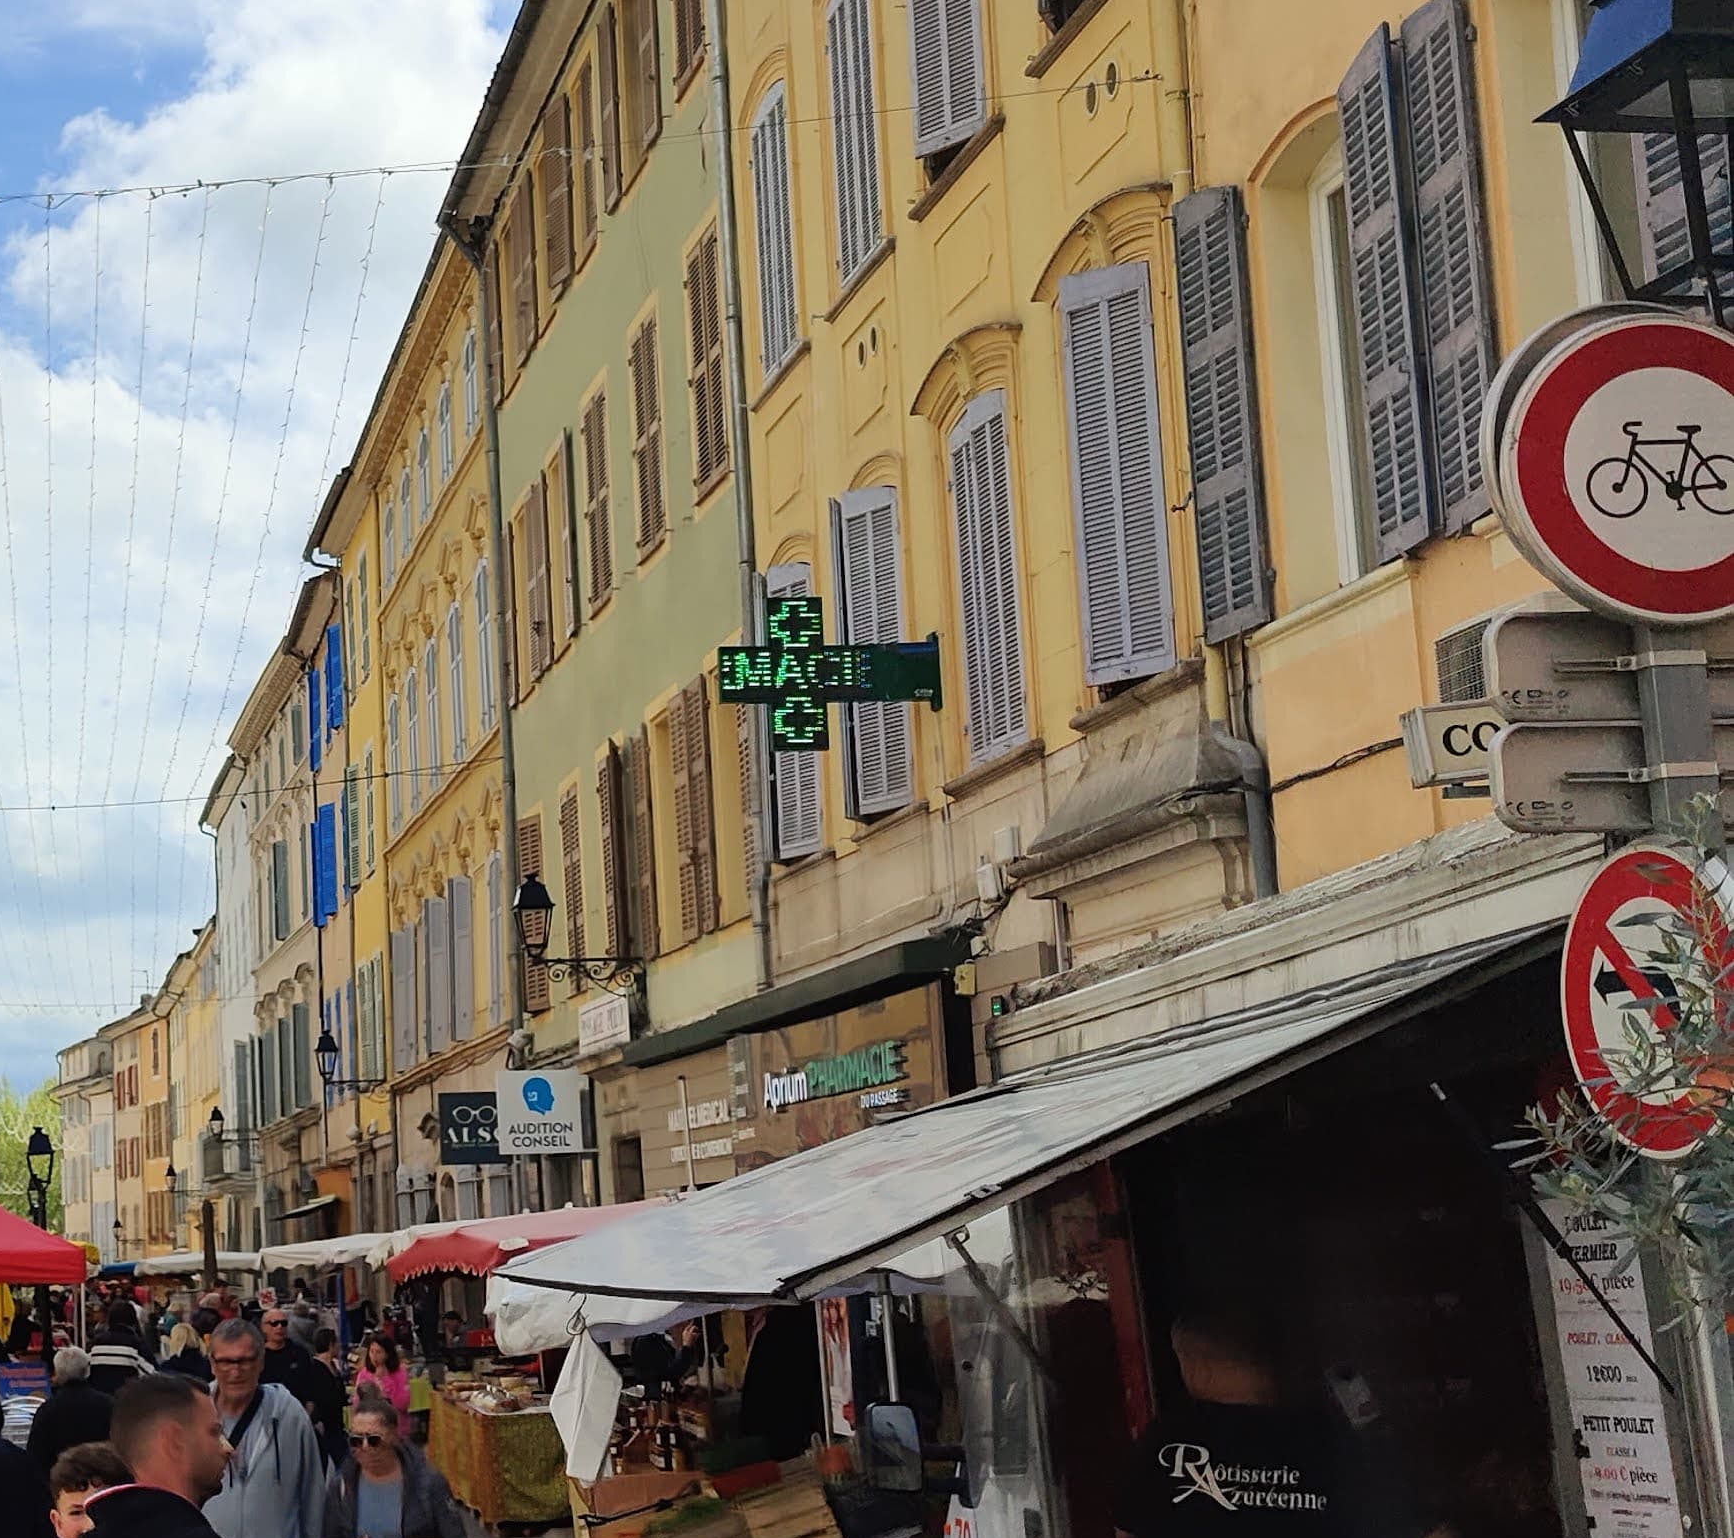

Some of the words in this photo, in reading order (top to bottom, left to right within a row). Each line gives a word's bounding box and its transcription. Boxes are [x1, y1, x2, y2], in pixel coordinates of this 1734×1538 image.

[763, 1066, 808, 1113] Aprium
[807, 1039, 898, 1098] PHARMACIE
[509, 1121, 573, 1136] AUDITION
[512, 1135, 571, 1149] CONSEIL
[1582, 1414, 1611, 1434] PETIT
[1613, 1415, 1655, 1435] POULET
[1158, 1442, 1301, 1486] Rôtisserie
